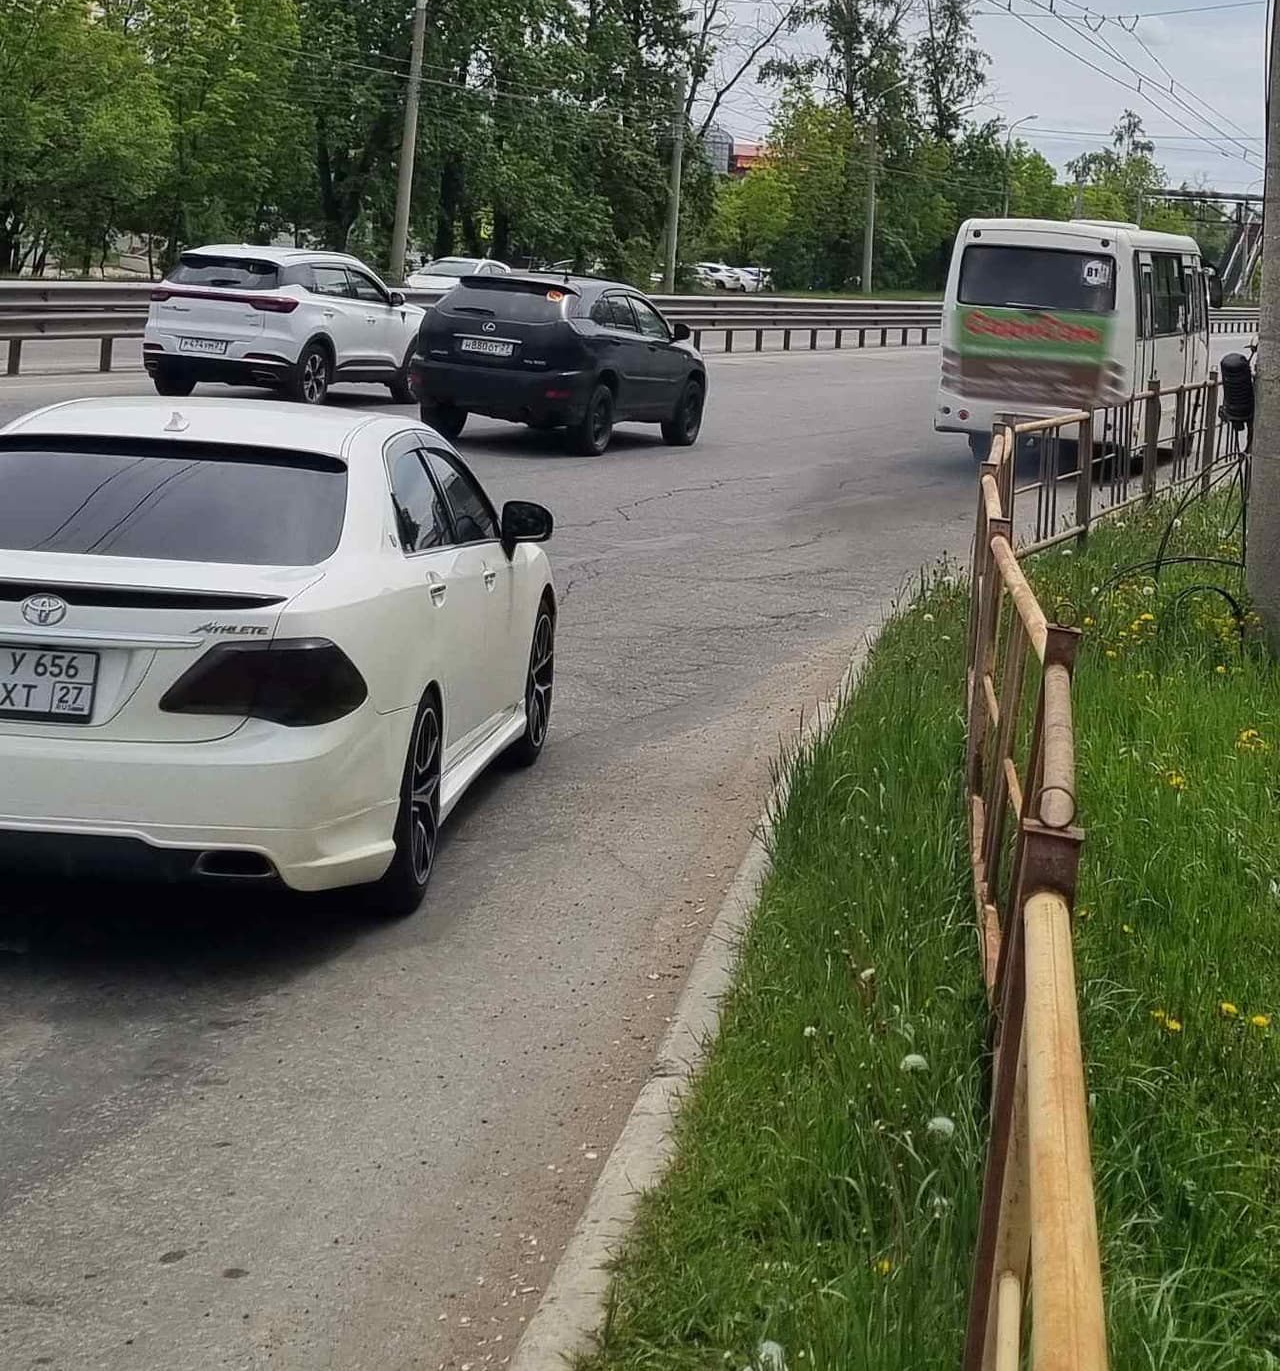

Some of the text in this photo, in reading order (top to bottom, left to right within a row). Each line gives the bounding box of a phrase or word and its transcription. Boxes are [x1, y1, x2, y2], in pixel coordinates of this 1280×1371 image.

[189, 621, 269, 635] ATHLETE
[10, 652, 79, 679] У 656
[0, 683, 83, 708] ХТ 27
